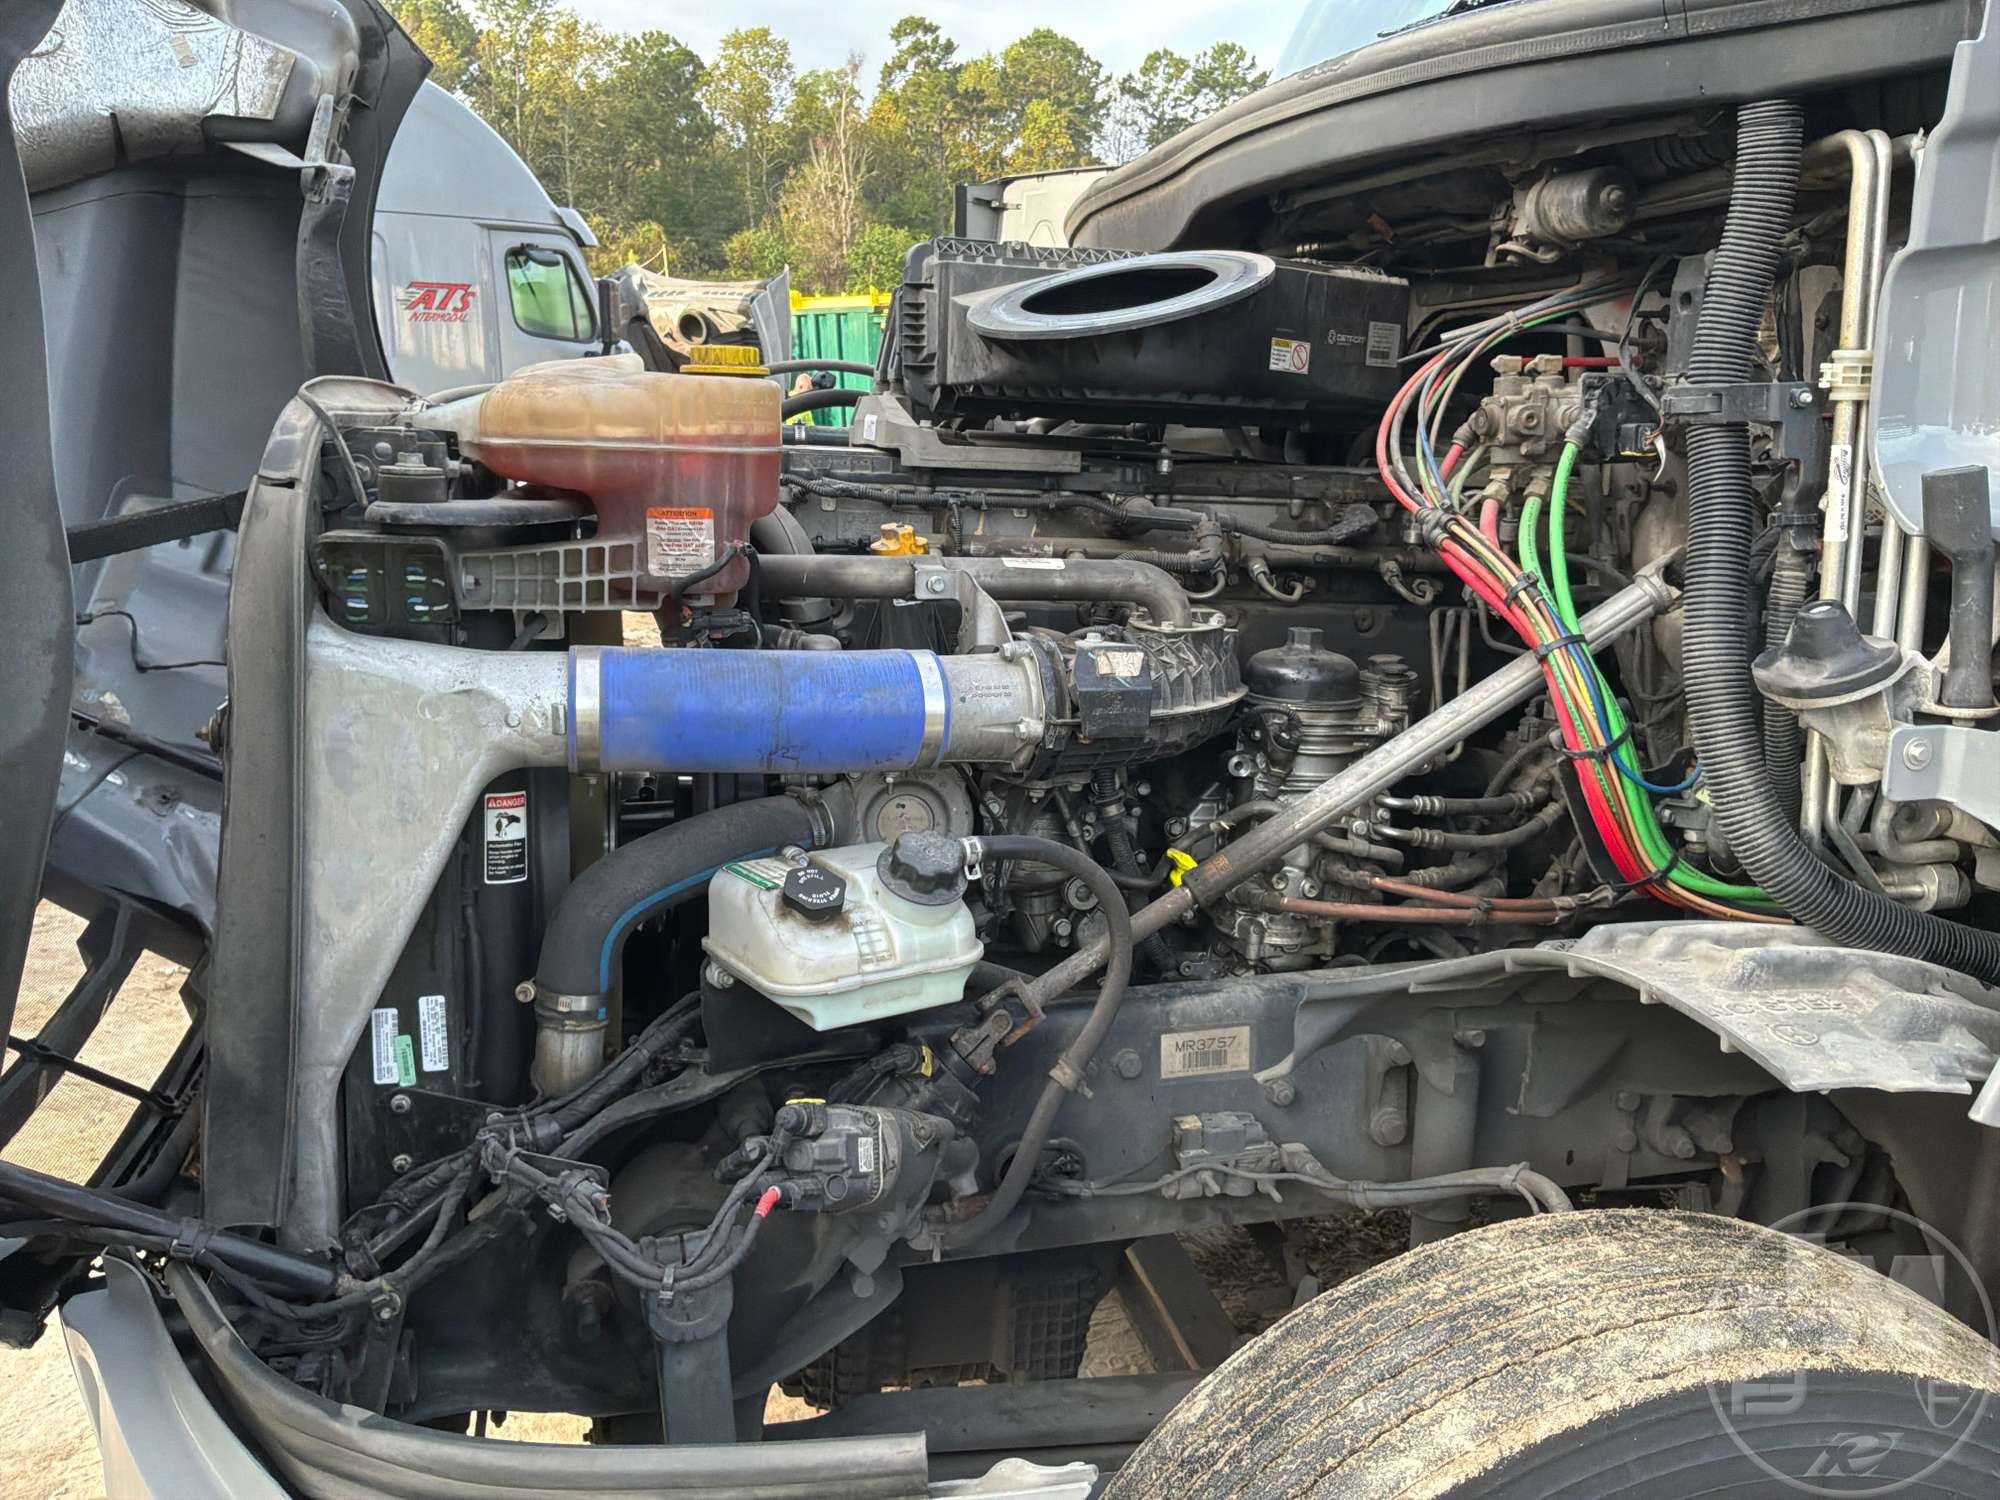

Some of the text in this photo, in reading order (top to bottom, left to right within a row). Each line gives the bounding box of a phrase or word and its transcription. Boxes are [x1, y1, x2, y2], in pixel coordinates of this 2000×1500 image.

[405, 282, 476, 312] ATS
[408, 312, 468, 322] INTERMODAL
[496, 797, 525, 807] DANGER
[1175, 1035, 1237, 1053] MR3757
